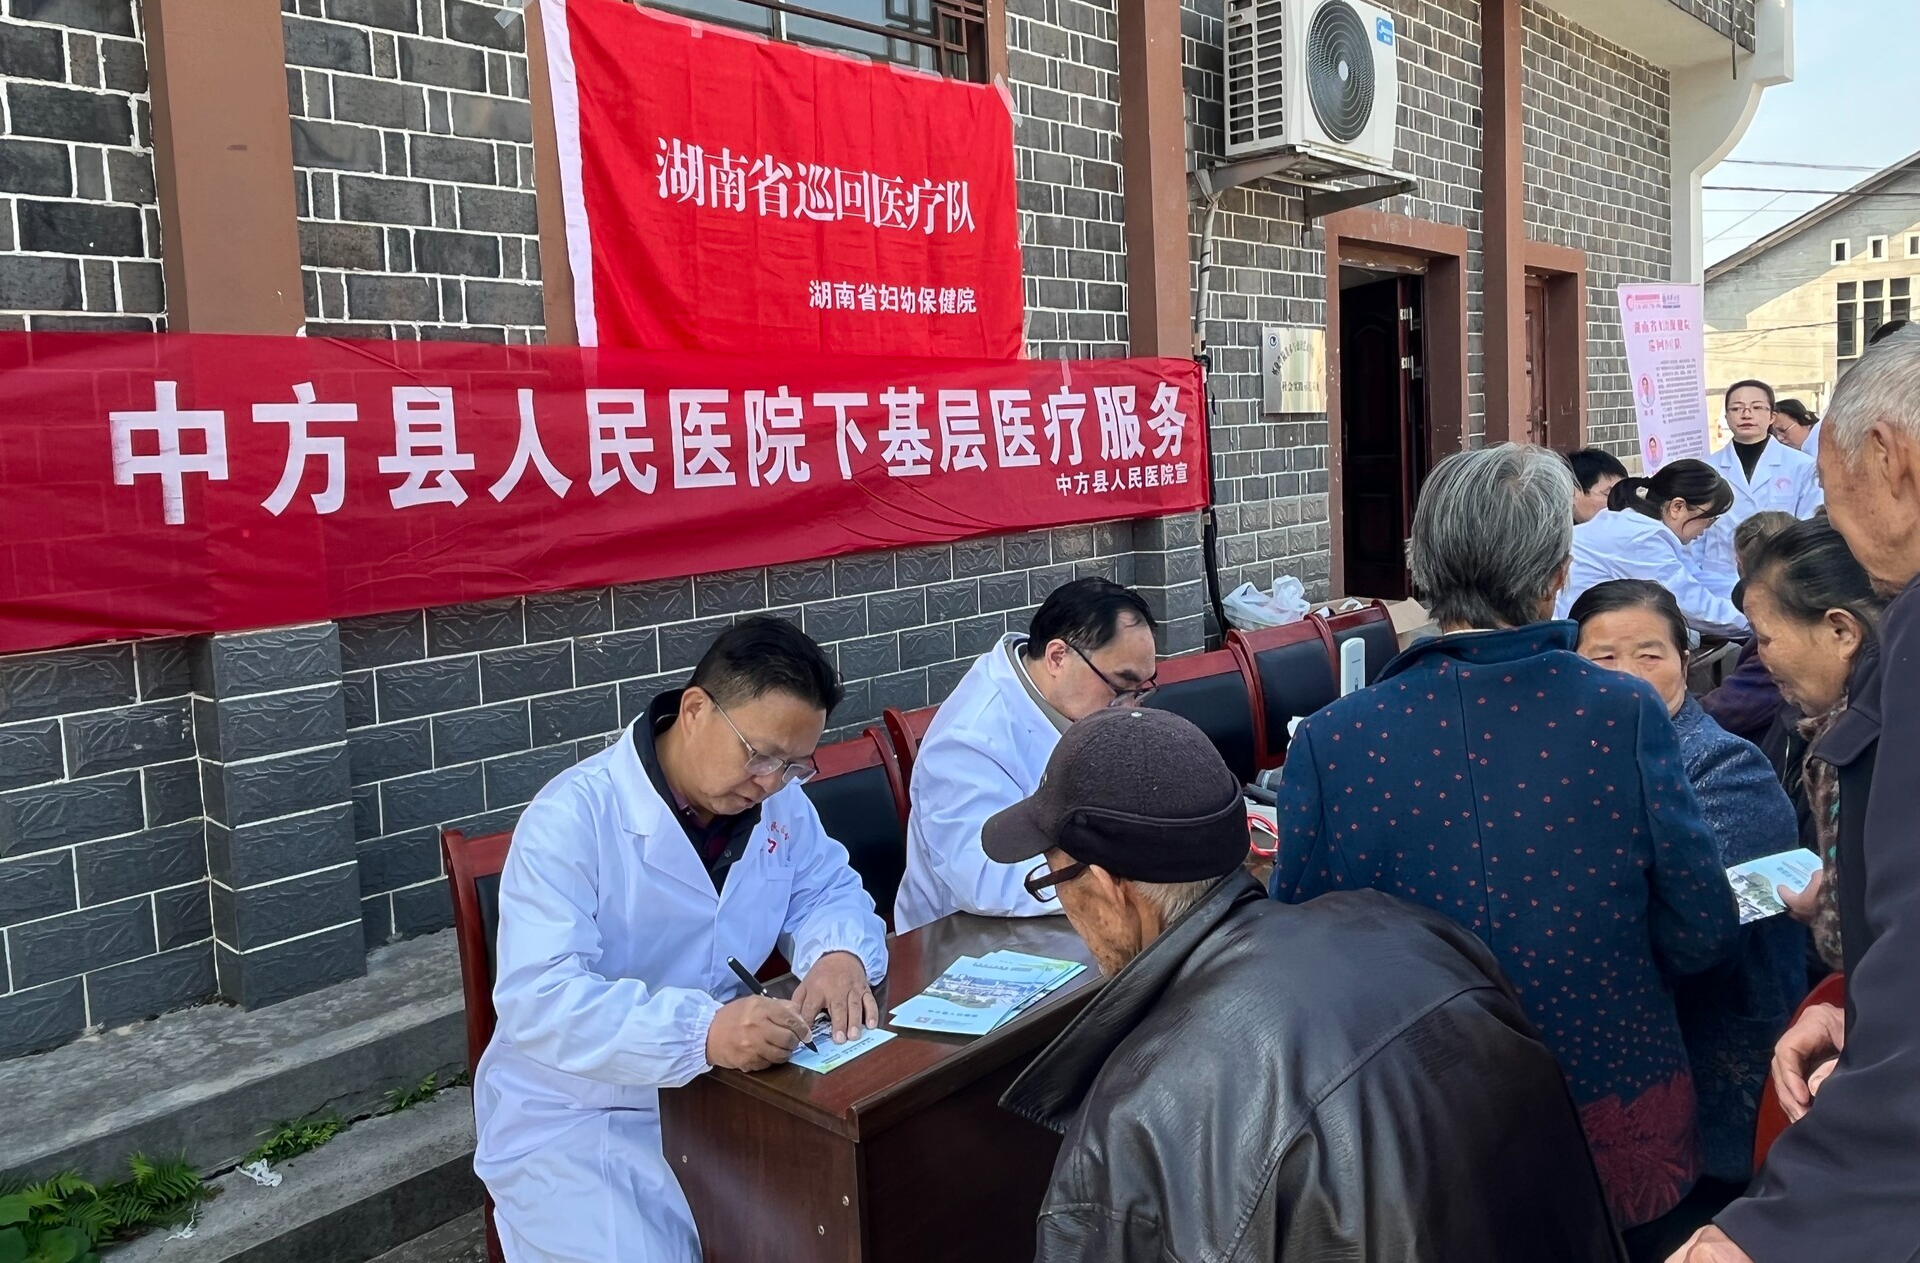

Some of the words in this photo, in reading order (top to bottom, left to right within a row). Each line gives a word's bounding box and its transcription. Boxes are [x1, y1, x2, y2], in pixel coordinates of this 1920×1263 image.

[656, 137, 976, 235] 湖南省巡回医疗队
[808, 279, 978, 316] 湖南省妇幼保健院
[109, 380, 1187, 526] 中方县人民医院下基层医疗服务
[1056, 461, 1187, 496] 中方县人民医院宣
